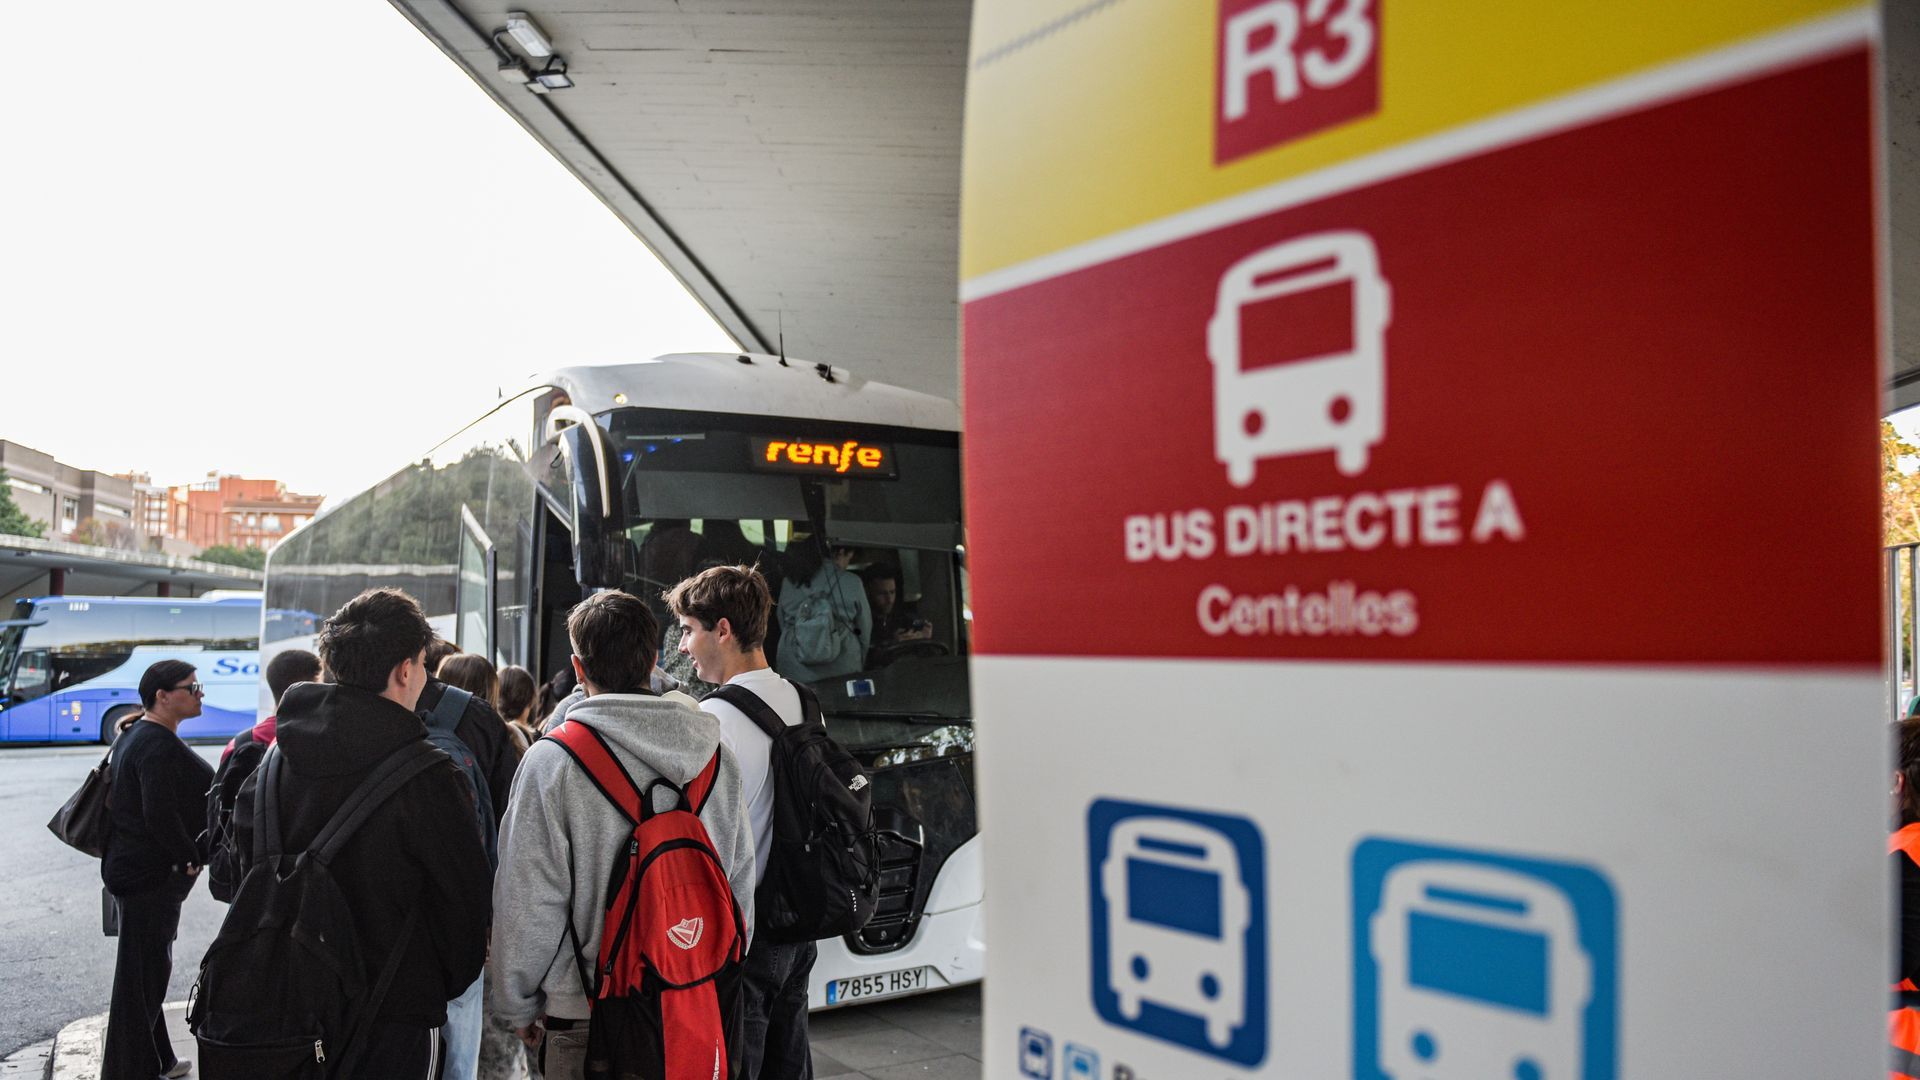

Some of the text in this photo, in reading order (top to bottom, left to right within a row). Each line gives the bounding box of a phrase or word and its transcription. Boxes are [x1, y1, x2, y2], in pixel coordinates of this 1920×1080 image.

[1225, 0, 1373, 121] R3
[766, 441, 882, 472] renfe
[1125, 480, 1524, 562] BUS DIRECTE A
[1197, 582, 1418, 636] Centelles
[840, 976, 884, 999] 7855
[890, 969, 922, 991] HSY
